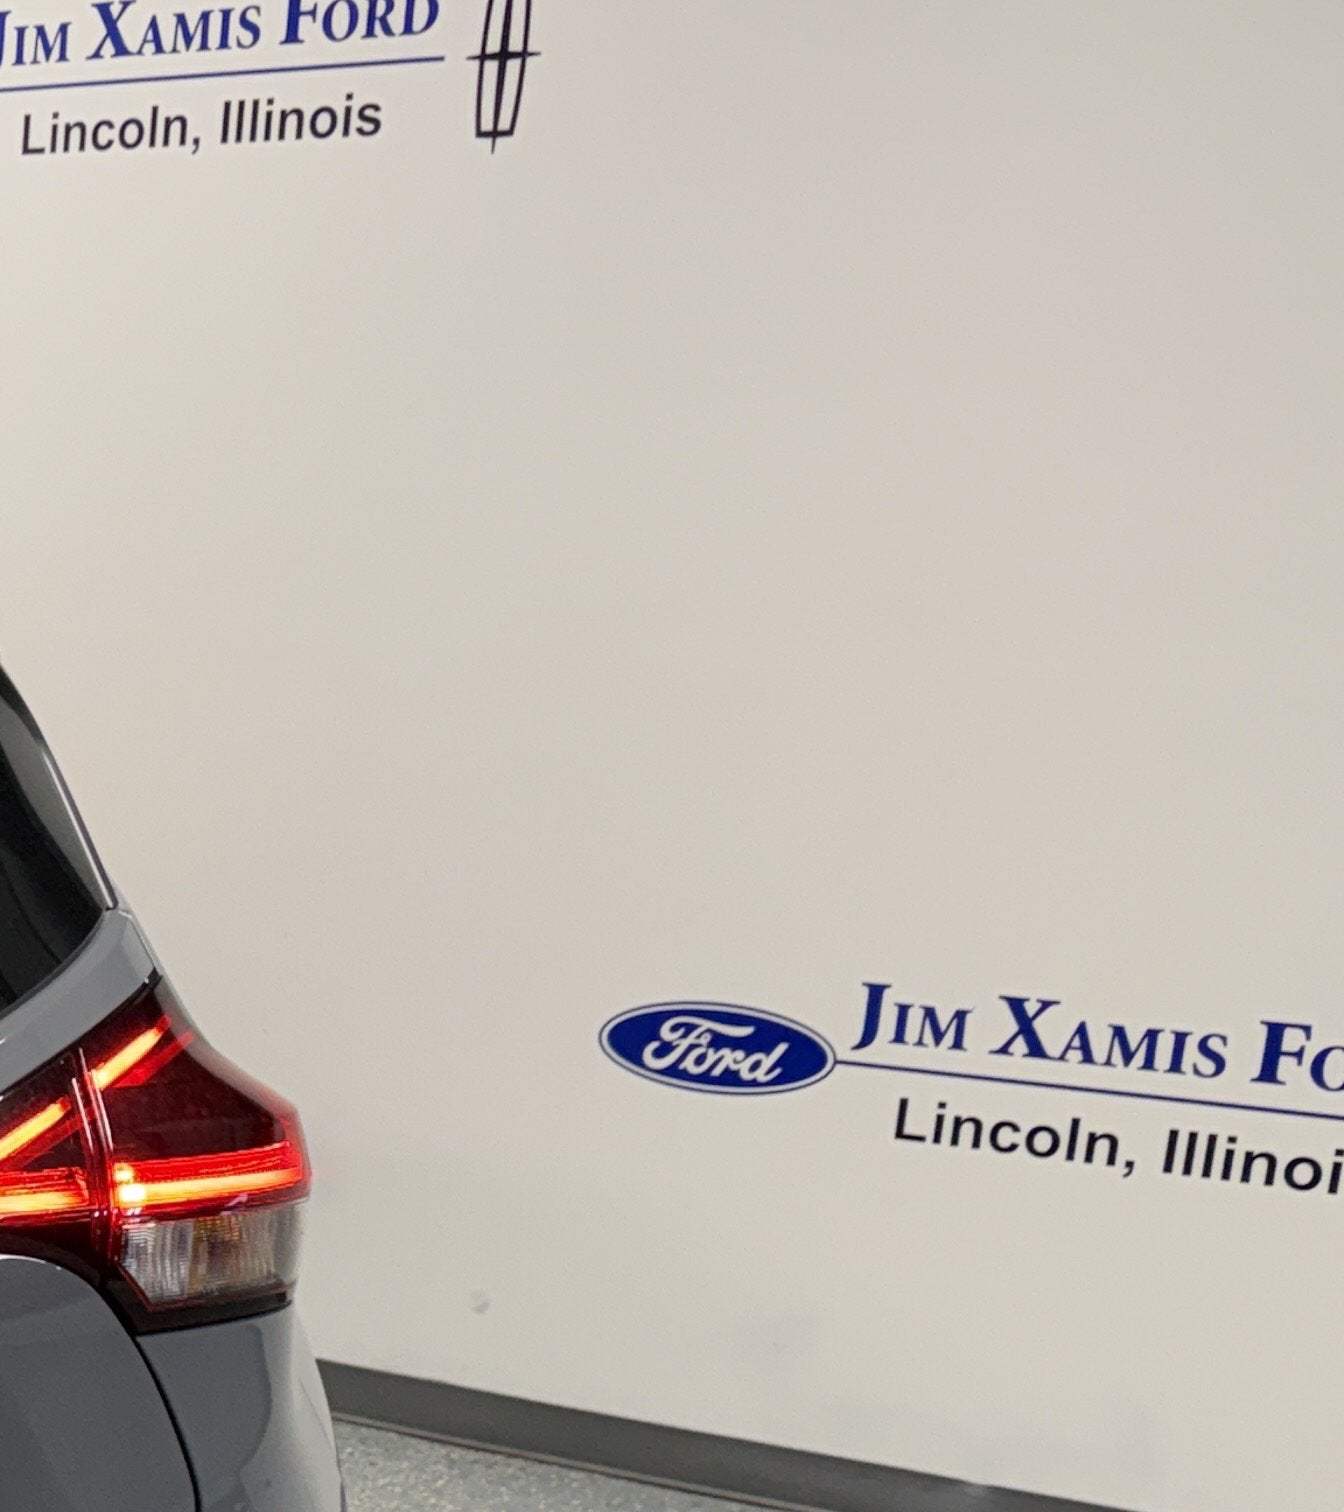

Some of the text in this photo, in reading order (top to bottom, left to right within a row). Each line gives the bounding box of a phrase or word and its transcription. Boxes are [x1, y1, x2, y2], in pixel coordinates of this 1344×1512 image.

[85, 0, 262, 60] XAMIS
[279, 0, 439, 45] FORD
[21, 94, 382, 155] Lincoln, Illinois
[642, 1015, 782, 1085] Ford
[851, 981, 976, 1051] JIM
[989, 994, 1228, 1078] XAMIS
[894, 1097, 1136, 1178] Lincoln,
